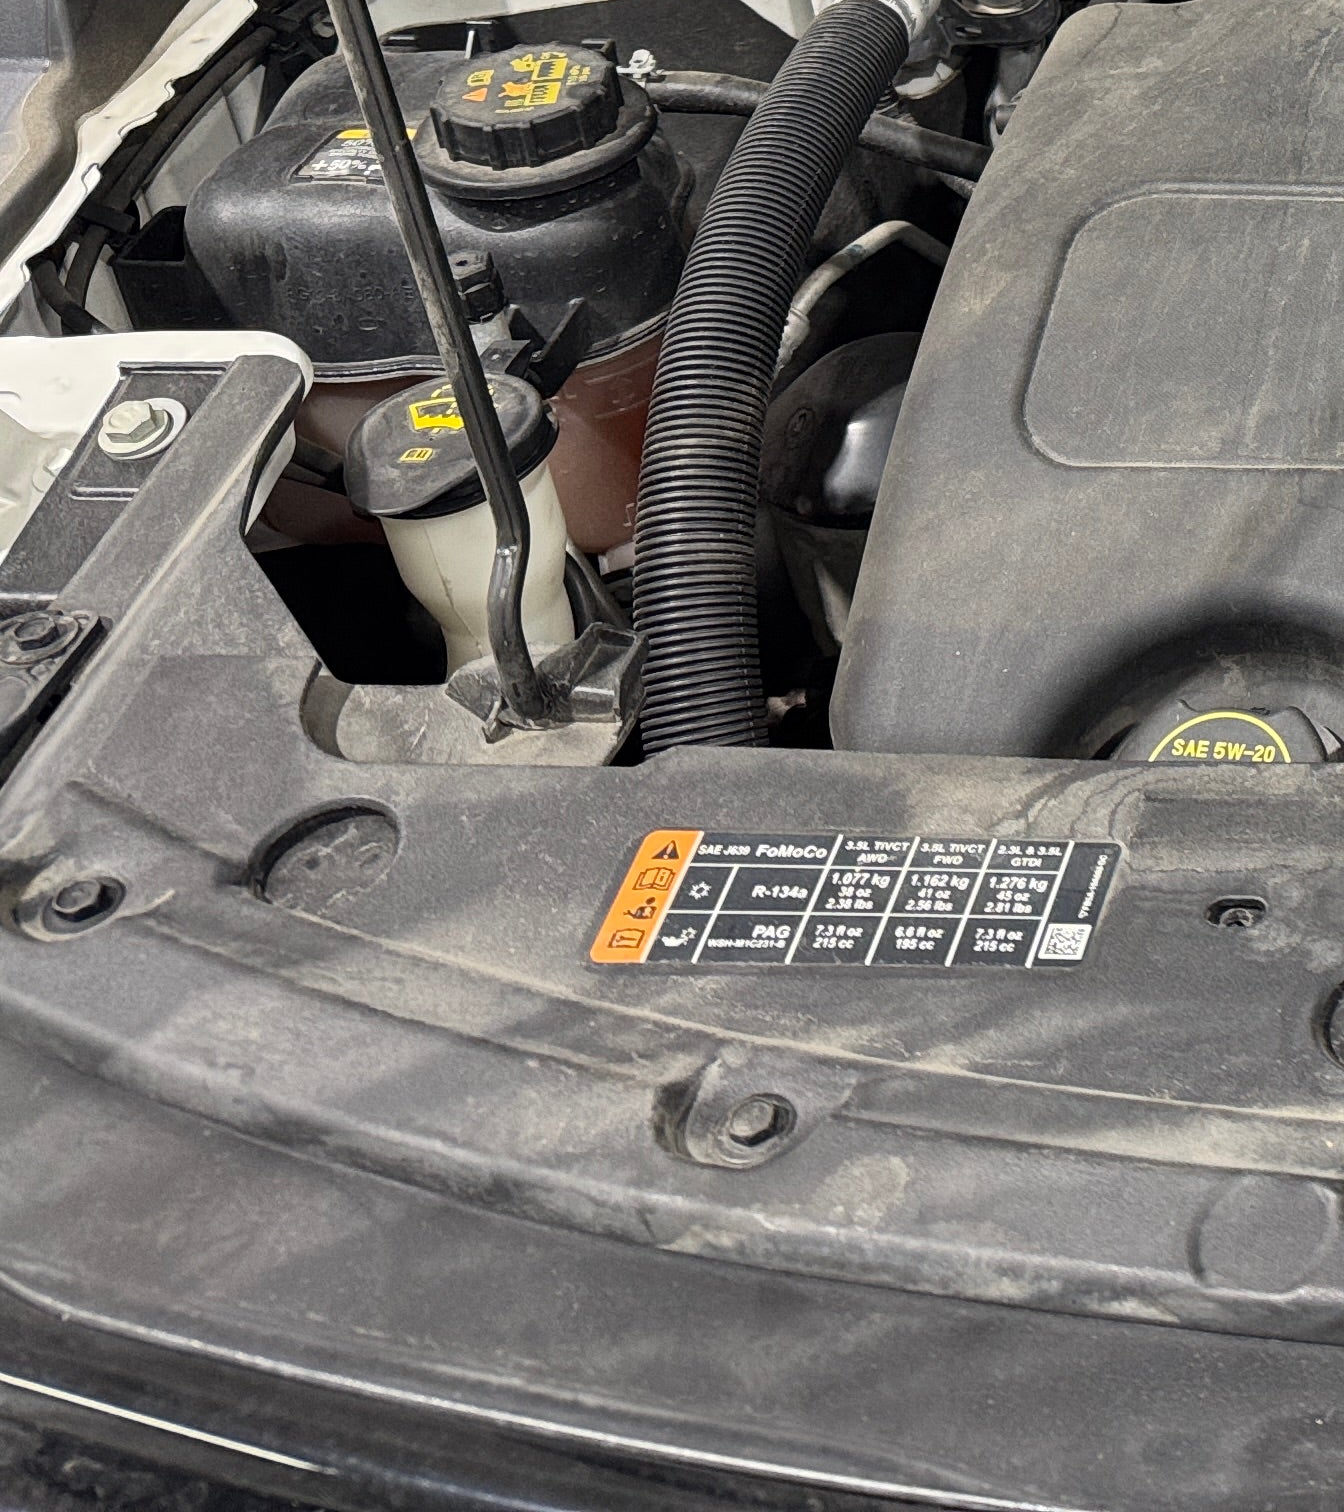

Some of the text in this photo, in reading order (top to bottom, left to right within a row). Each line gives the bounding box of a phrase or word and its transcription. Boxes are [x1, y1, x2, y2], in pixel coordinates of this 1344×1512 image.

[1171, 738, 1275, 762] SAE 5W-20
[697, 844, 828, 859] SAE J639 FoMoCo
[845, 841, 870, 851] 3.5L
[921, 843, 945, 853] 3.5L
[1037, 846, 1062, 856] 3.5L
[857, 853, 887, 863] AWD
[933, 855, 963, 865] FWD
[831, 872, 891, 888] 1.077 kg
[911, 874, 970, 890] 1.162 kg
[989, 876, 1048, 893] 1.276 kg
[752, 885, 808, 899] R-134a
[838, 887, 872, 898] 38 oz
[918, 888, 951, 899] 41 oz
[996, 891, 1030, 902] 45 oz
[825, 898, 874, 909] 2.38 lbs
[905, 899, 953, 911] 2.56 lbs
[984, 902, 1032, 914] 2.81 lbs
[752, 925, 791, 938] PAG
[815, 925, 834, 937] 7.3
[847, 927, 864, 937] oz
[927, 928, 945, 938] oz
[975, 928, 995, 940] 7.3
[1007, 931, 1023, 941] oz
[812, 938, 855, 949] 215 cc
[896, 939, 935, 950] 195 cc
[973, 940, 1015, 952] 215 cc
